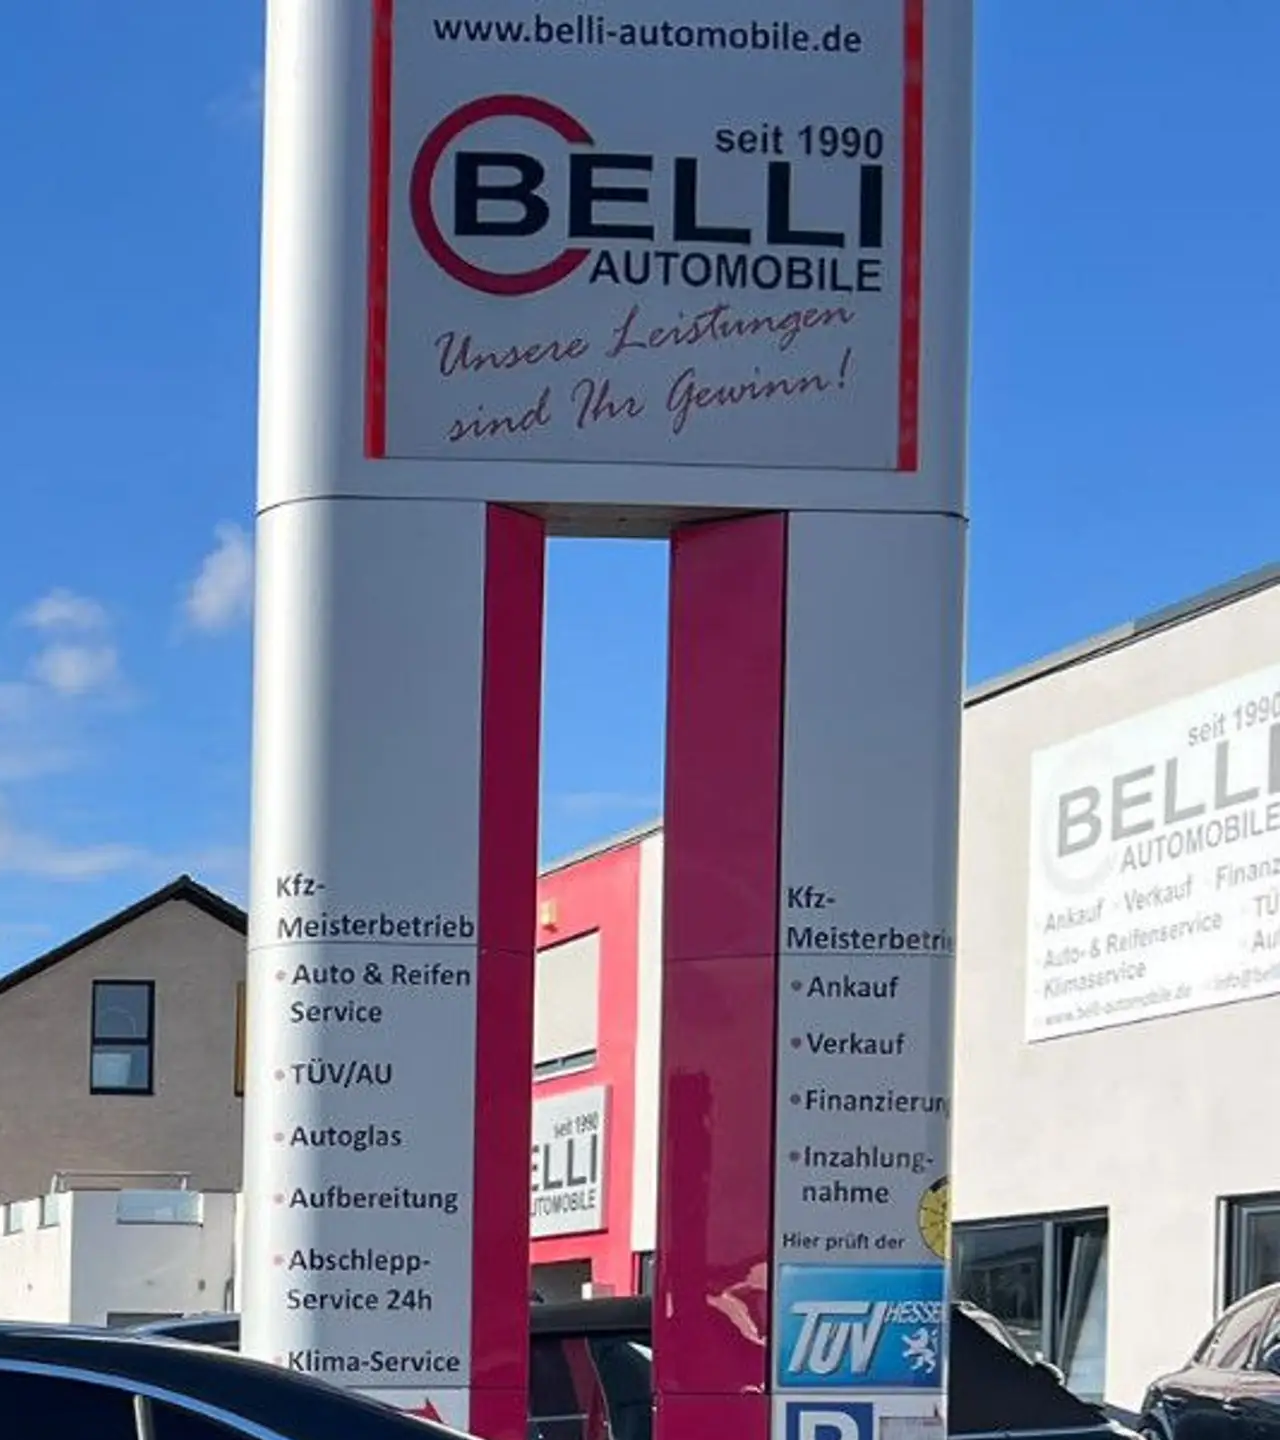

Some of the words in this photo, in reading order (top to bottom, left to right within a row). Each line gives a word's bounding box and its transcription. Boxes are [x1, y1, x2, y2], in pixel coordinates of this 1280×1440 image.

[434, 15, 862, 52] www.belli-automobile.de
[716, 124, 784, 155] seit
[799, 126, 883, 158] 1990
[454, 151, 883, 248] BELLI
[589, 249, 882, 292] AUTOMOBILE
[434, 331, 589, 377] Unsere
[606, 303, 854, 357] Leistungen
[449, 386, 551, 441] sind
[571, 377, 645, 429] Ihr
[666, 348, 852, 434] Gewinn!
[1188, 713, 1226, 747] seit
[1058, 723, 1280, 858] BELLI
[1120, 801, 1280, 874] AUTOMOBILE
[277, 873, 326, 897] Kfz-
[788, 886, 835, 908] Kfz-
[1124, 873, 1193, 913] Verkauf
[277, 913, 474, 938] Meisterbetrieb
[292, 964, 355, 985] Auto
[363, 963, 383, 985] &
[392, 963, 470, 985] Reifen
[807, 975, 900, 998] Ankauf
[290, 1001, 382, 1022] Service
[807, 1032, 905, 1054] Verkauf
[291, 1058, 392, 1088] TÜV/AU
[290, 1125, 402, 1152] Autoglas
[805, 1146, 934, 1174] Inzahlung-
[290, 1186, 458, 1214] Aufbereitung
[802, 1180, 890, 1204] nahme
[783, 1232, 818, 1249] Hier
[825, 1232, 869, 1251] prüft
[875, 1233, 905, 1250] der
[288, 1249, 431, 1275] Abschlepp-
[287, 1289, 379, 1310] Service
[387, 1289, 432, 1310] 24h
[289, 1350, 460, 1372] Klima-Service
